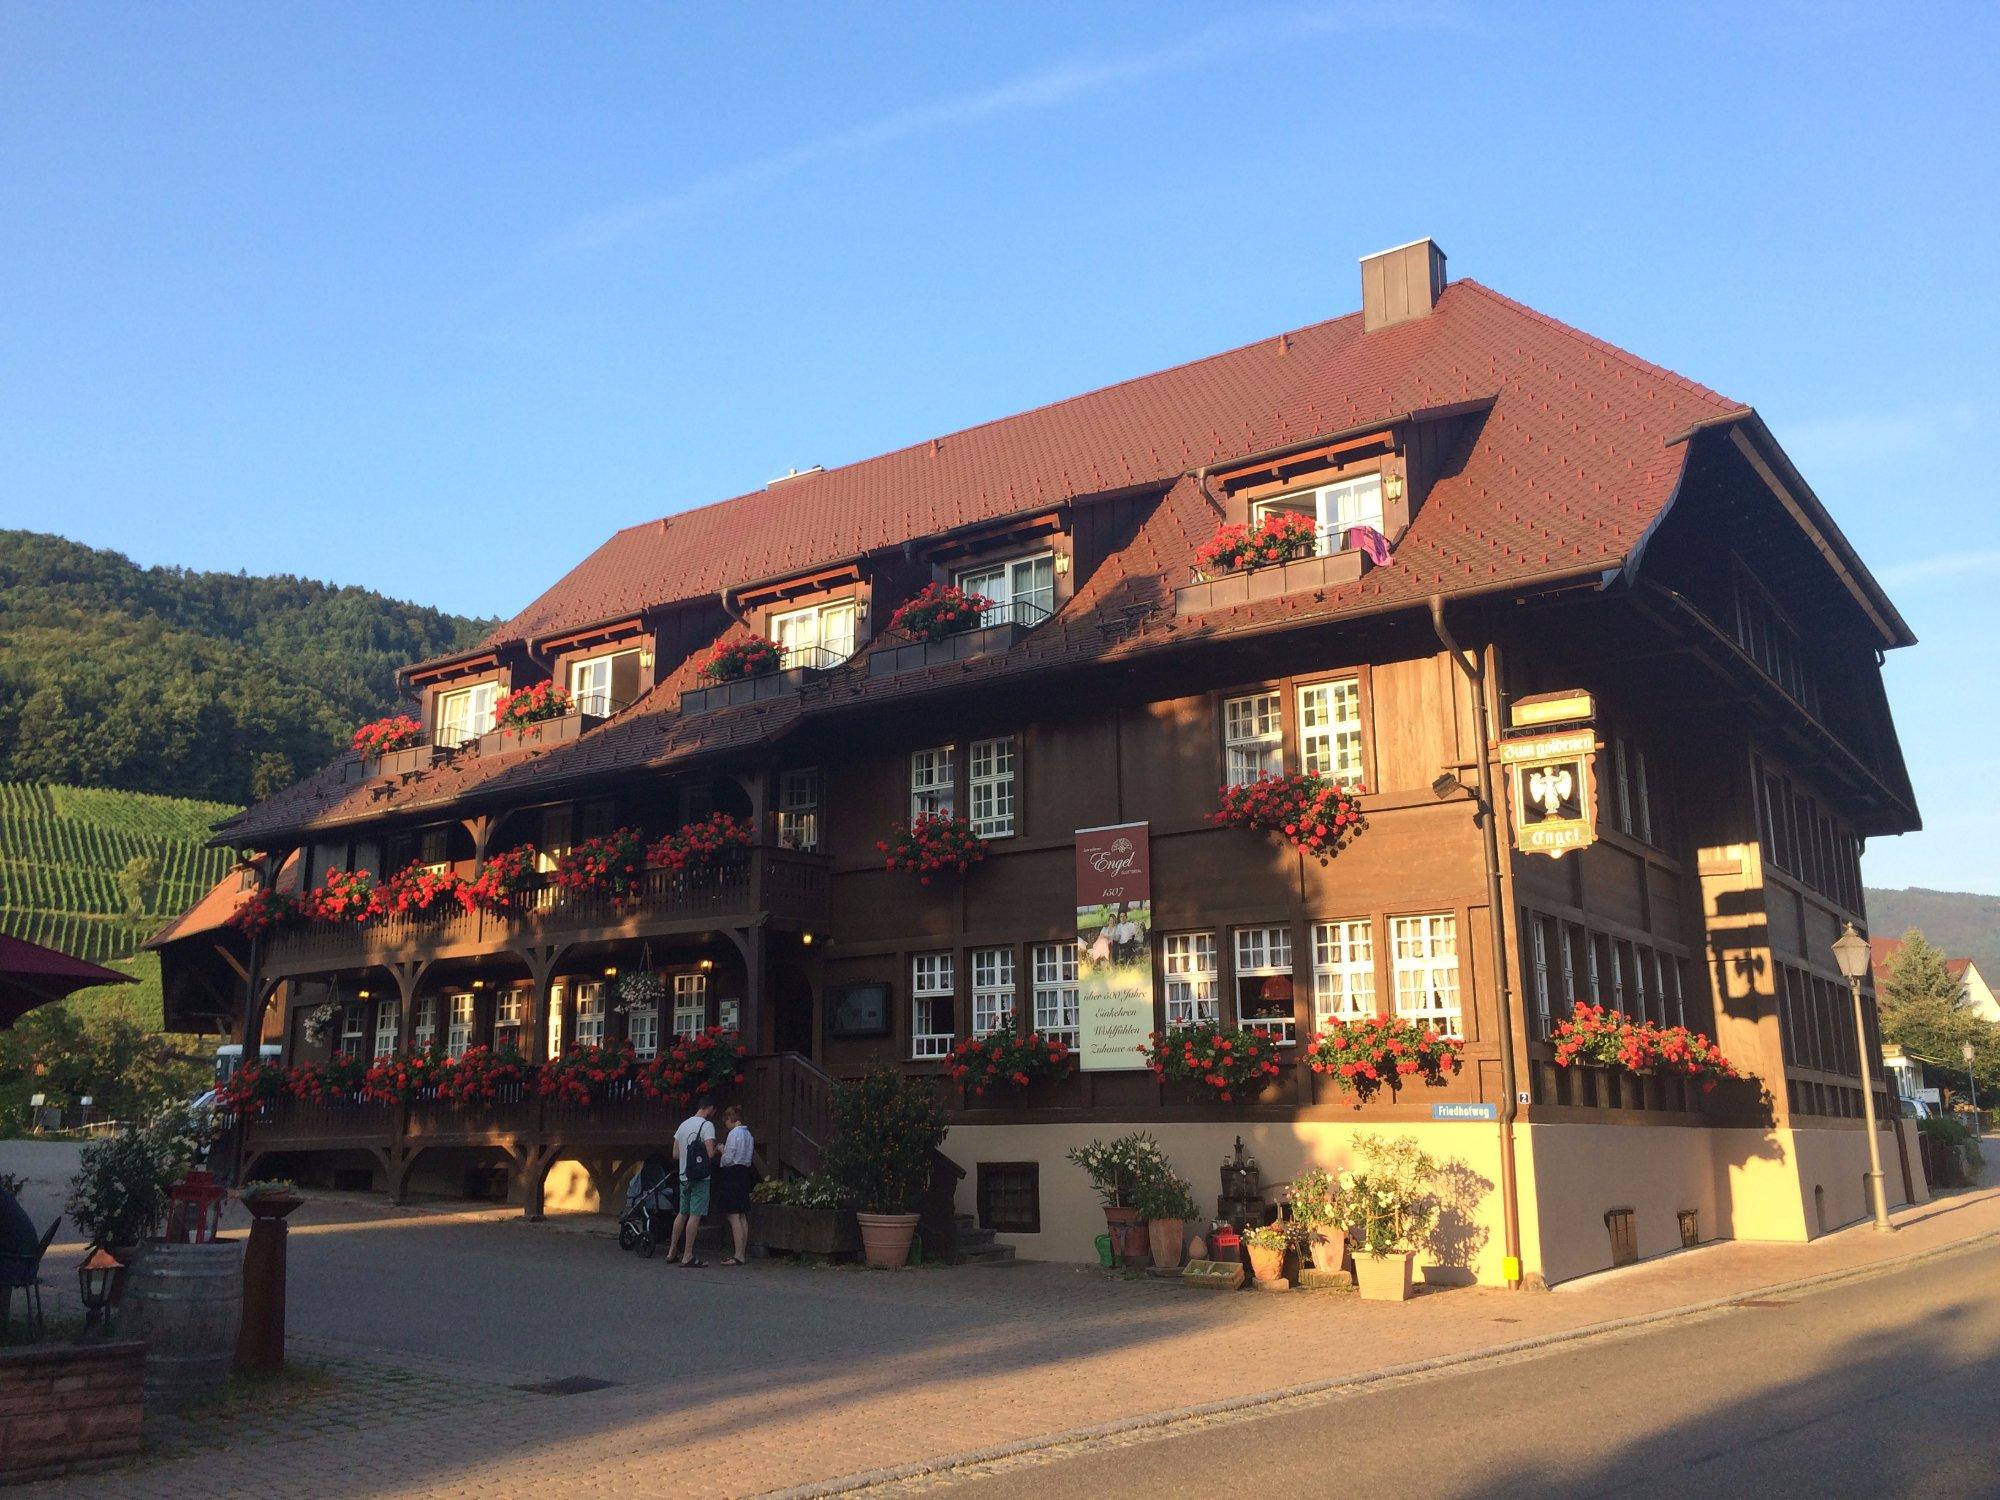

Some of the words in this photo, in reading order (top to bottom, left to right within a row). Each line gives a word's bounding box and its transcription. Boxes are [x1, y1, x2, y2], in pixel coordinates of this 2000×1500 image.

[1532, 828, 1579, 846] Engel
[1089, 851, 1136, 877] Engel
[1102, 887, 1124, 897] 1507
[1083, 991, 1102, 1001] über
[1121, 988, 1147, 1002] Jahre
[1095, 1007, 1137, 1018] Einkehren
[1095, 1024, 1140, 1038] Wohlfühlen
[1090, 1043, 1125, 1054] Zuhause
[1521, 1094, 1528, 1103] 2
[1438, 1105, 1489, 1118] Friedhofweg
